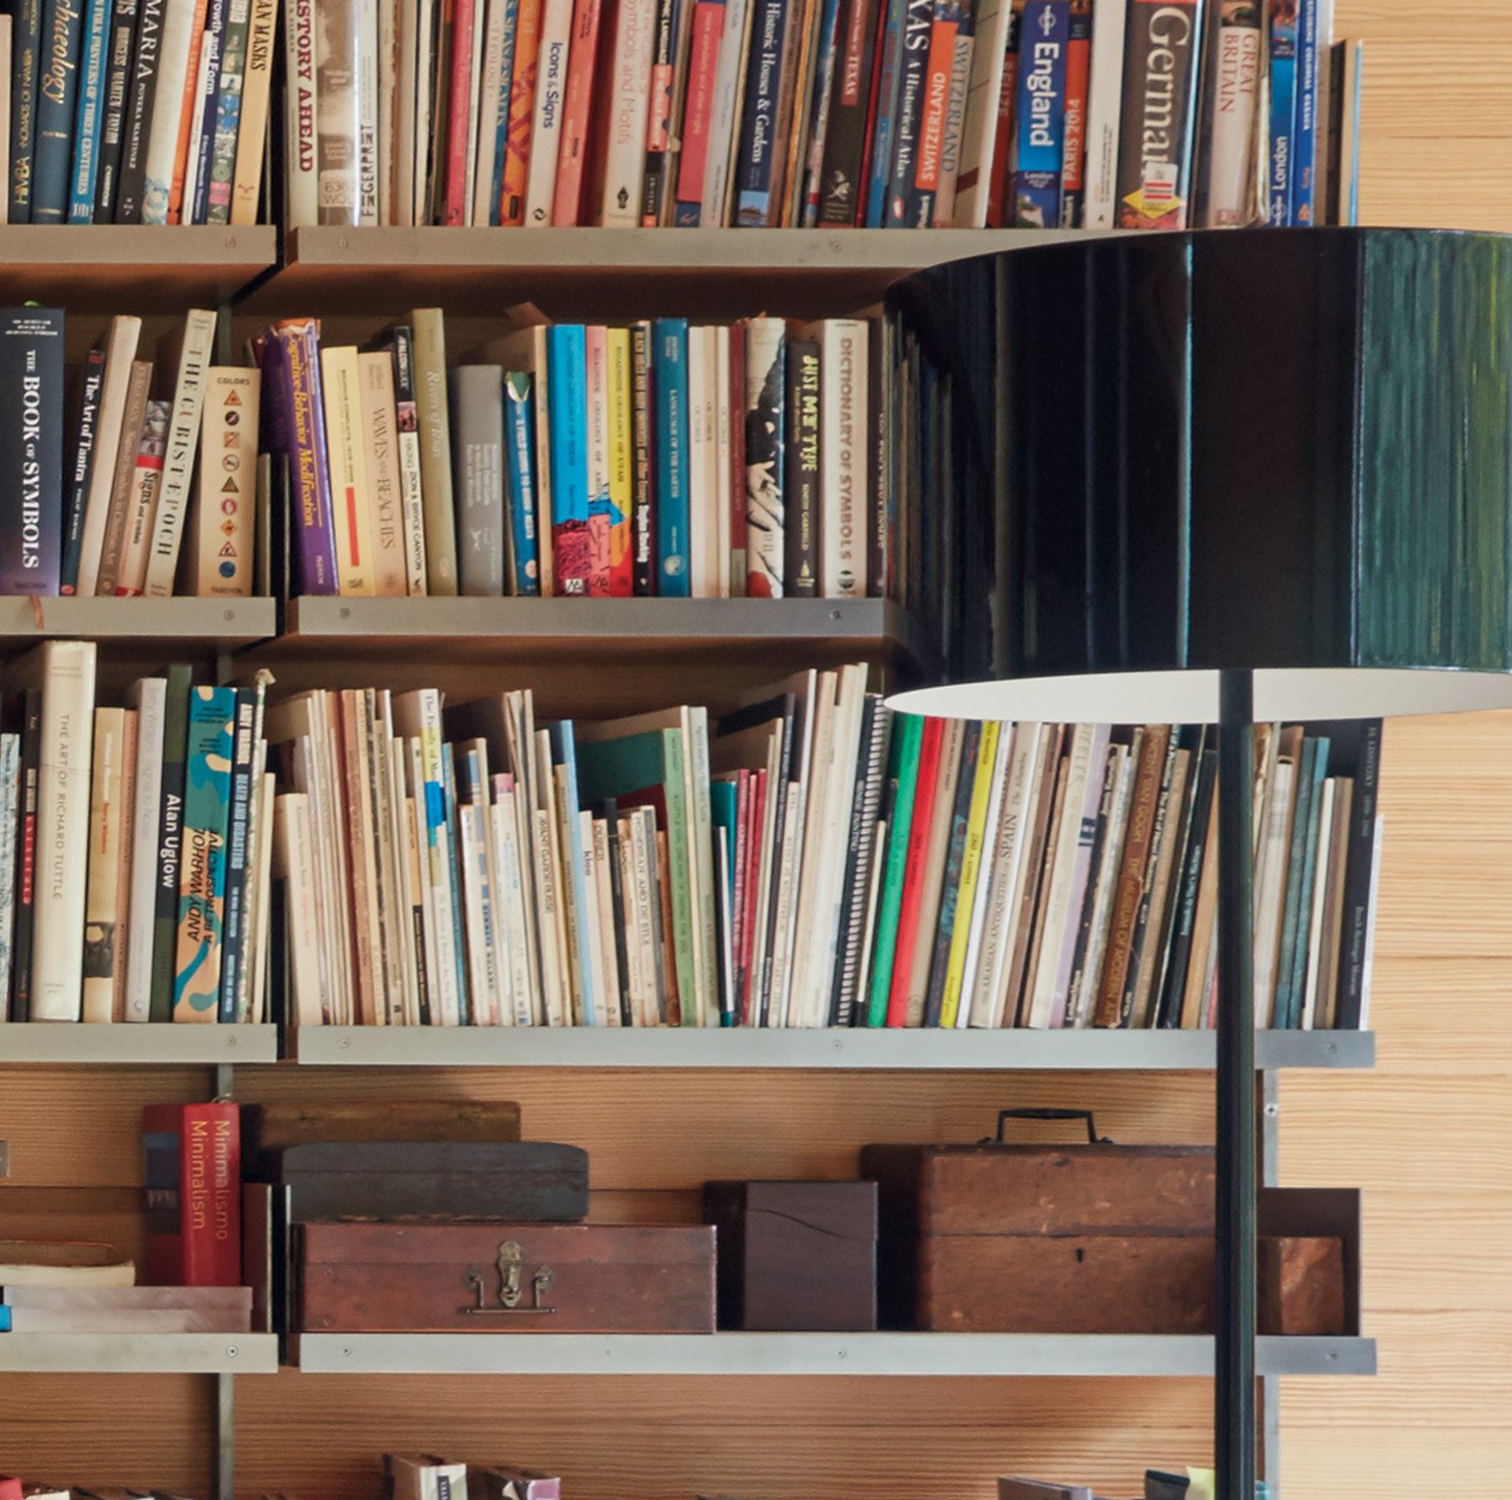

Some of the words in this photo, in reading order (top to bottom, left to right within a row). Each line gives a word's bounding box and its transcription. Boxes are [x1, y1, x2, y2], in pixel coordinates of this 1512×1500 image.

[251, 25, 269, 70] MASKS
[759, 2, 781, 48] Historic
[757, 53, 775, 95] Houses
[1029, 42, 1059, 146] England
[757, 98, 772, 110] &
[298, 87, 313, 172] AHEAD
[752, 114, 770, 163] Gardens
[26, 349, 37, 372] THE
[23, 376, 40, 441] BOOK
[840, 337, 852, 447] DICTIONARY
[26, 444, 36, 458] OF
[841, 451, 851, 469] OF
[23, 461, 41, 569] SYMBOLS
[840, 475, 851, 560] SYMBOLS
[164, 794, 182, 833] Alan
[161, 837, 180, 888] Uglow
[192, 1120, 205, 1229] Minimalism
[215, 1120, 229, 1239] Minimalismo
